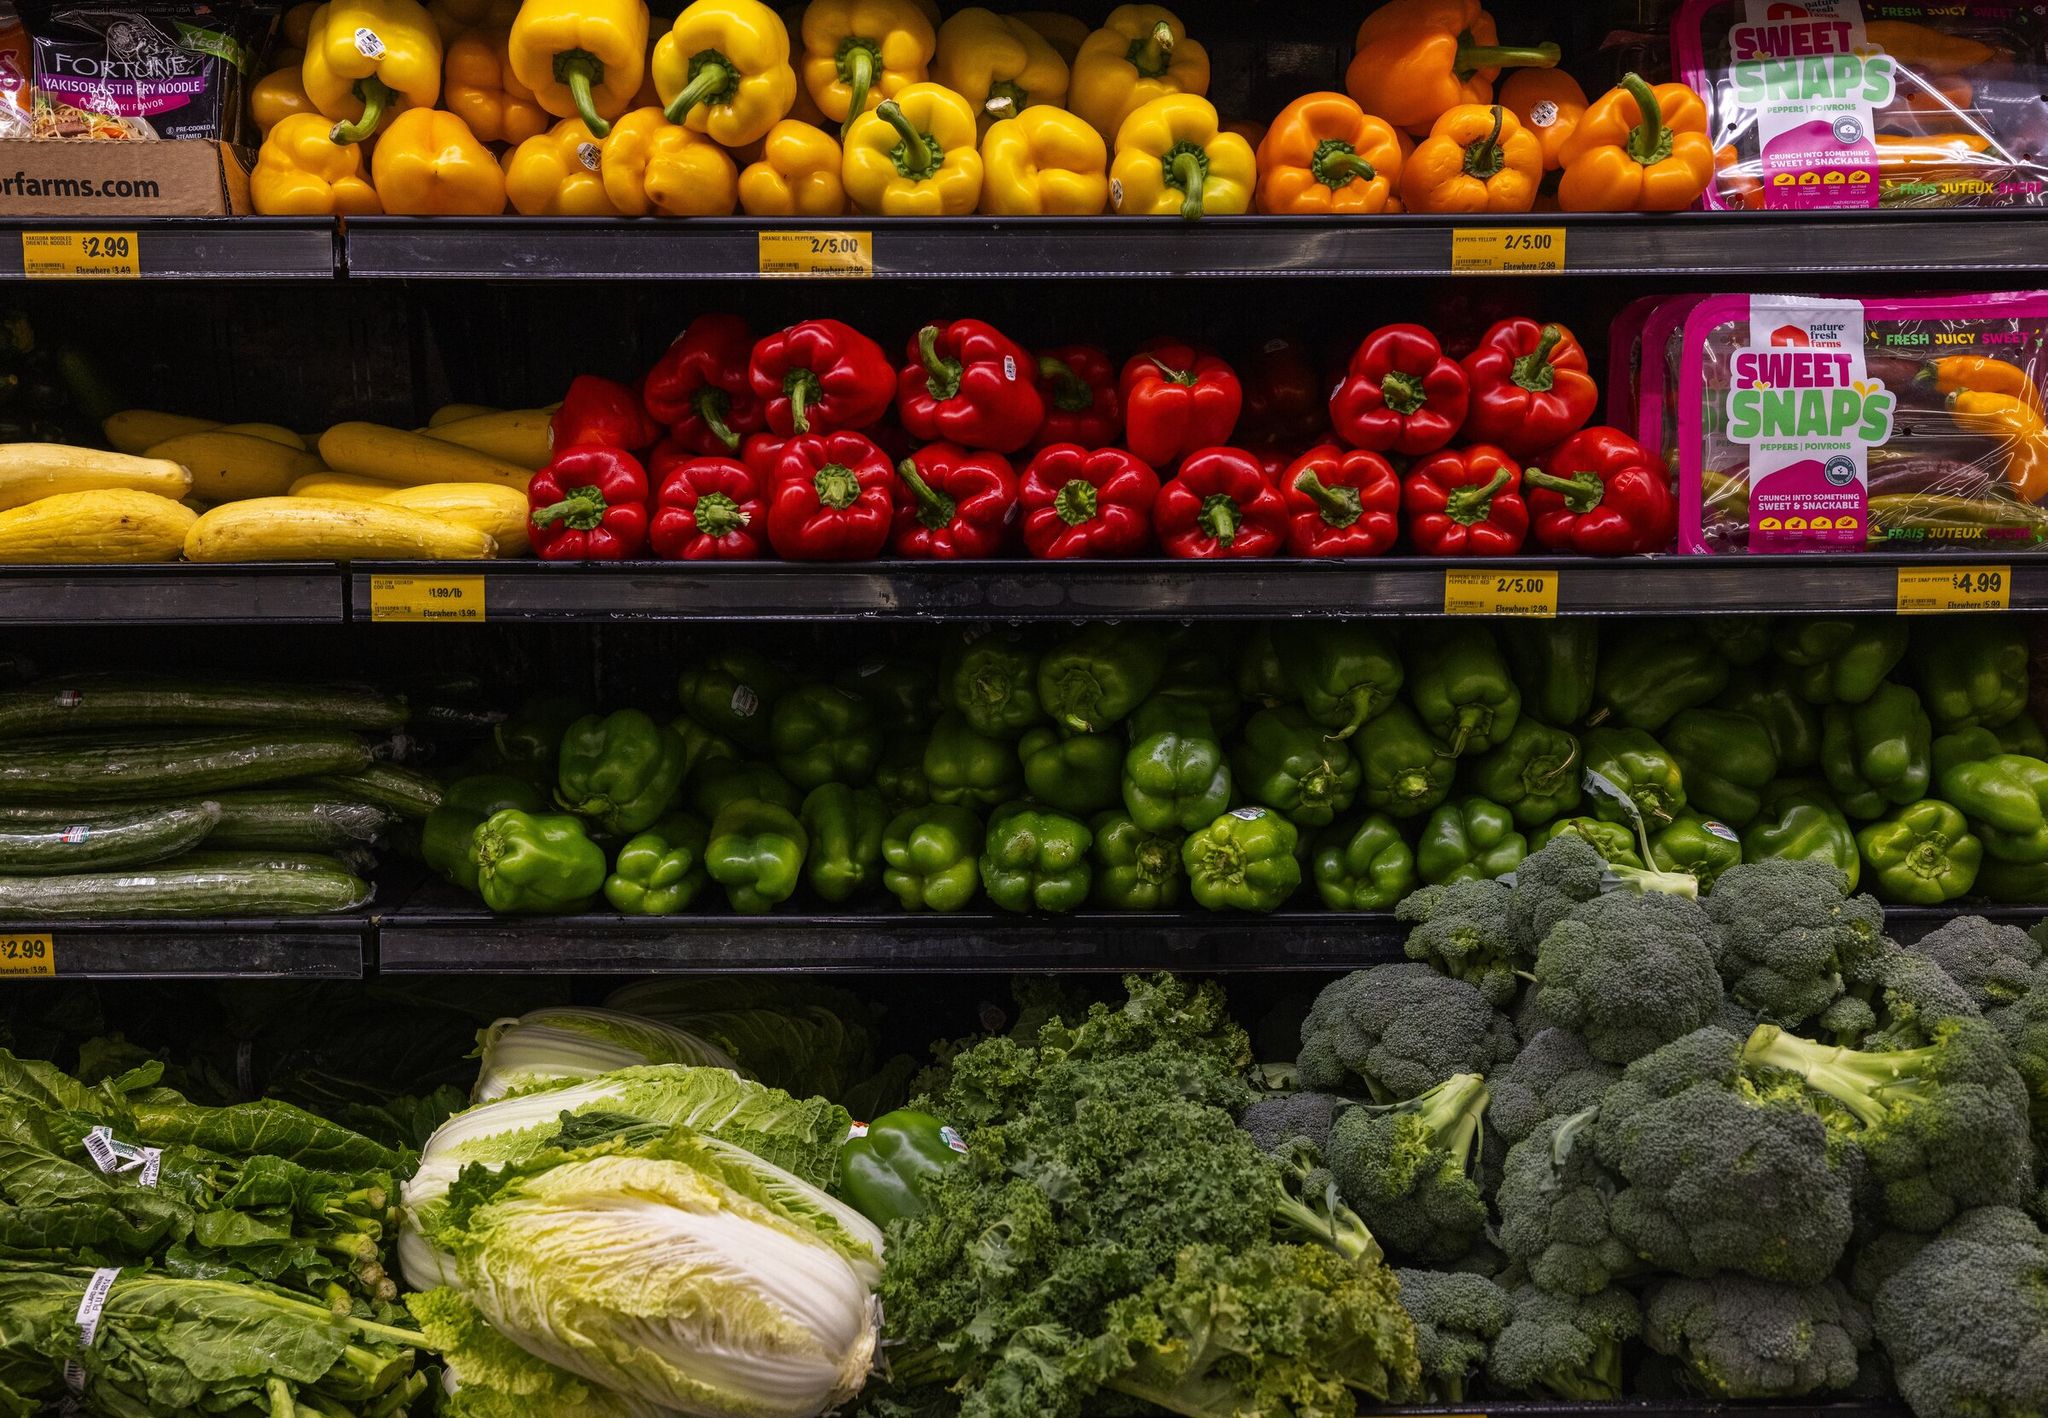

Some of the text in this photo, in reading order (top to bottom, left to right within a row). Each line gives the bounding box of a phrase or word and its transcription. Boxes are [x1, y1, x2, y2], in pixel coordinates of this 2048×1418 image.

[1882, 7, 1922, 17] FRESH
[1735, 21, 1853, 60] SWEET
[1735, 55, 1891, 103] SNAPS
[43, 78, 200, 95] YAKISOBA STIR FRY NOODLE
[1767, 103, 1857, 113] PEPPERS POIVRONS
[1769, 153, 1802, 161] CRUNCH
[1770, 157, 1871, 168] SWEET & SNACKABLE
[0, 171, 160, 198] rfarms.com
[1900, 183, 1937, 195] FRAIS
[1941, 182, 1994, 194] JUTEUX
[82, 235, 129, 258] $2.99
[811, 239, 858, 254] 2/5.00
[1504, 234, 1552, 250] 2/5.00
[76, 266, 111, 275] Elsewhere
[1503, 262, 1537, 271] Elsewhere
[1810, 323, 1845, 331] nature
[1810, 331, 1838, 340] fresh
[1886, 332, 2030, 346] FRESH JUICY SWEET
[1811, 340, 1842, 348] farms
[1736, 352, 1853, 389] SWEET
[1732, 389, 1891, 442] SNAPS
[1760, 442, 1852, 452] PEPPERS POIVRONS
[1758, 494, 1791, 502] CRUNCH
[1813, 493, 1860, 501] SOMETHING
[1758, 501, 1860, 511] SWEET & SNACKABLE
[1888, 528, 1925, 540] FRAIS
[1928, 527, 1983, 539] JUTEUX
[1497, 578, 1544, 593] 2/5.00
[1952, 572, 2002, 594] $4.99
[1496, 604, 1529, 613] Elsewhere
[1947, 601, 1981, 609] Elsewhere
[423, 609, 457, 618] Elsewhere
[1, 940, 46, 960] $2.99
[0, 966, 29, 974] lsewhere
